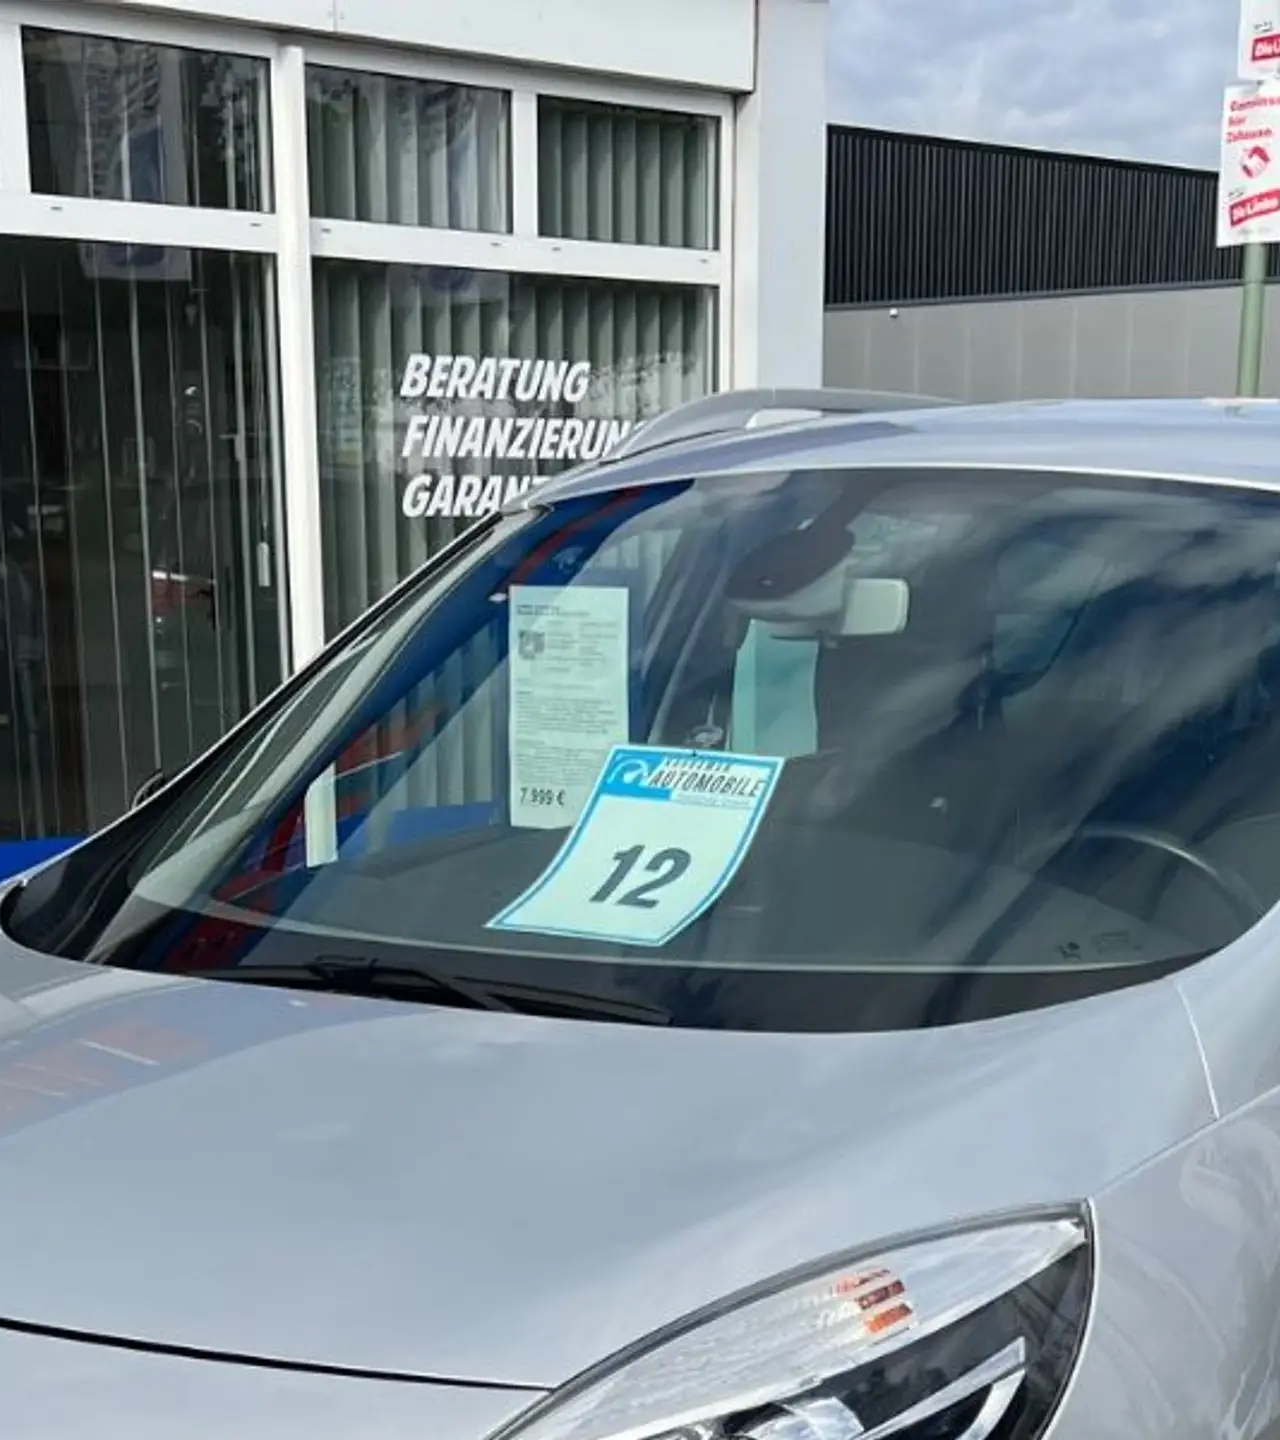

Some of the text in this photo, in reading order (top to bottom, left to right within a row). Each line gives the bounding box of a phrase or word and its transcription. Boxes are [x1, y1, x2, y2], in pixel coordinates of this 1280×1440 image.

[400, 353, 591, 402] BERATUNG
[402, 414, 647, 460] FINANZIERUN
[556, 789, 566, 806] €
[648, 769, 761, 798] AUTOMOBILE
[589, 843, 692, 910] 12
